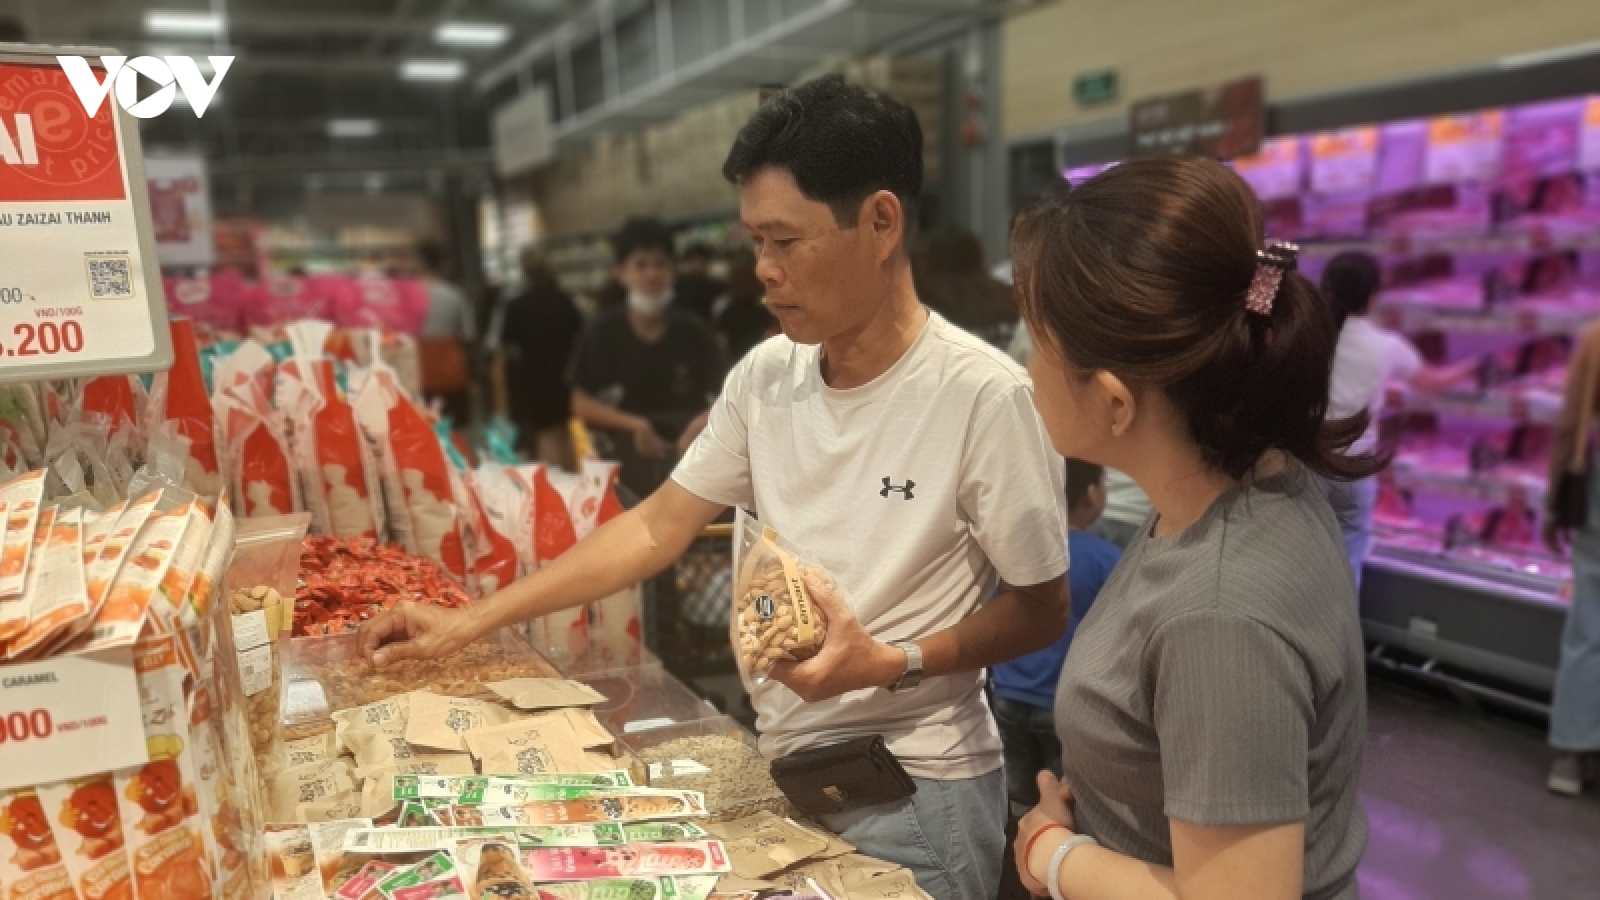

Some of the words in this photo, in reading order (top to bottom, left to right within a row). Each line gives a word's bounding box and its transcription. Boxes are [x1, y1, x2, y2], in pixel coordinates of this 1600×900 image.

[16, 212, 62, 226] ZAIZAI
[65, 211, 111, 225] THANH
[0, 320, 85, 357] .200
[2, 672, 59, 688] CARAMEL
